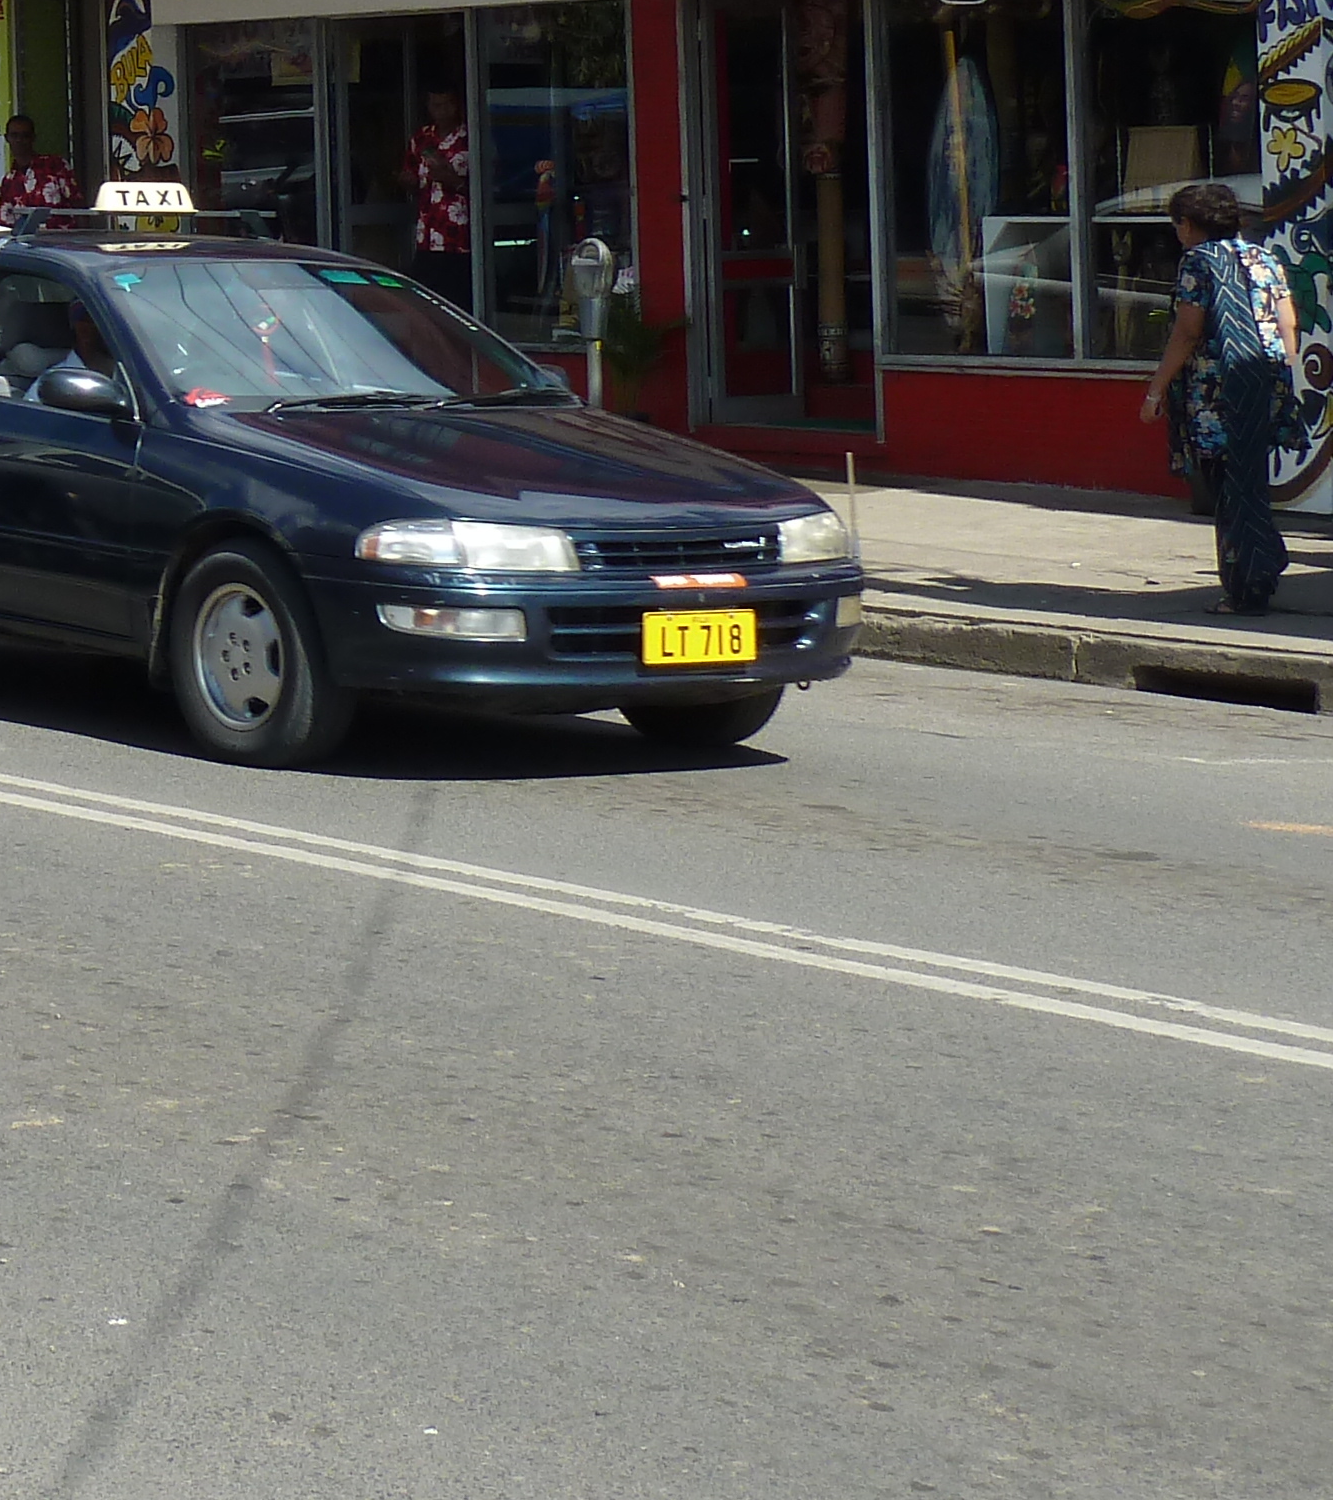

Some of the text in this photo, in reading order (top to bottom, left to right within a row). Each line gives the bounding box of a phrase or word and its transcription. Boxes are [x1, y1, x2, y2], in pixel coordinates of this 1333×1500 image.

[110, 34, 153, 104] BULA
[115, 190, 182, 206] TAXI
[661, 623, 742, 658] LT 718
